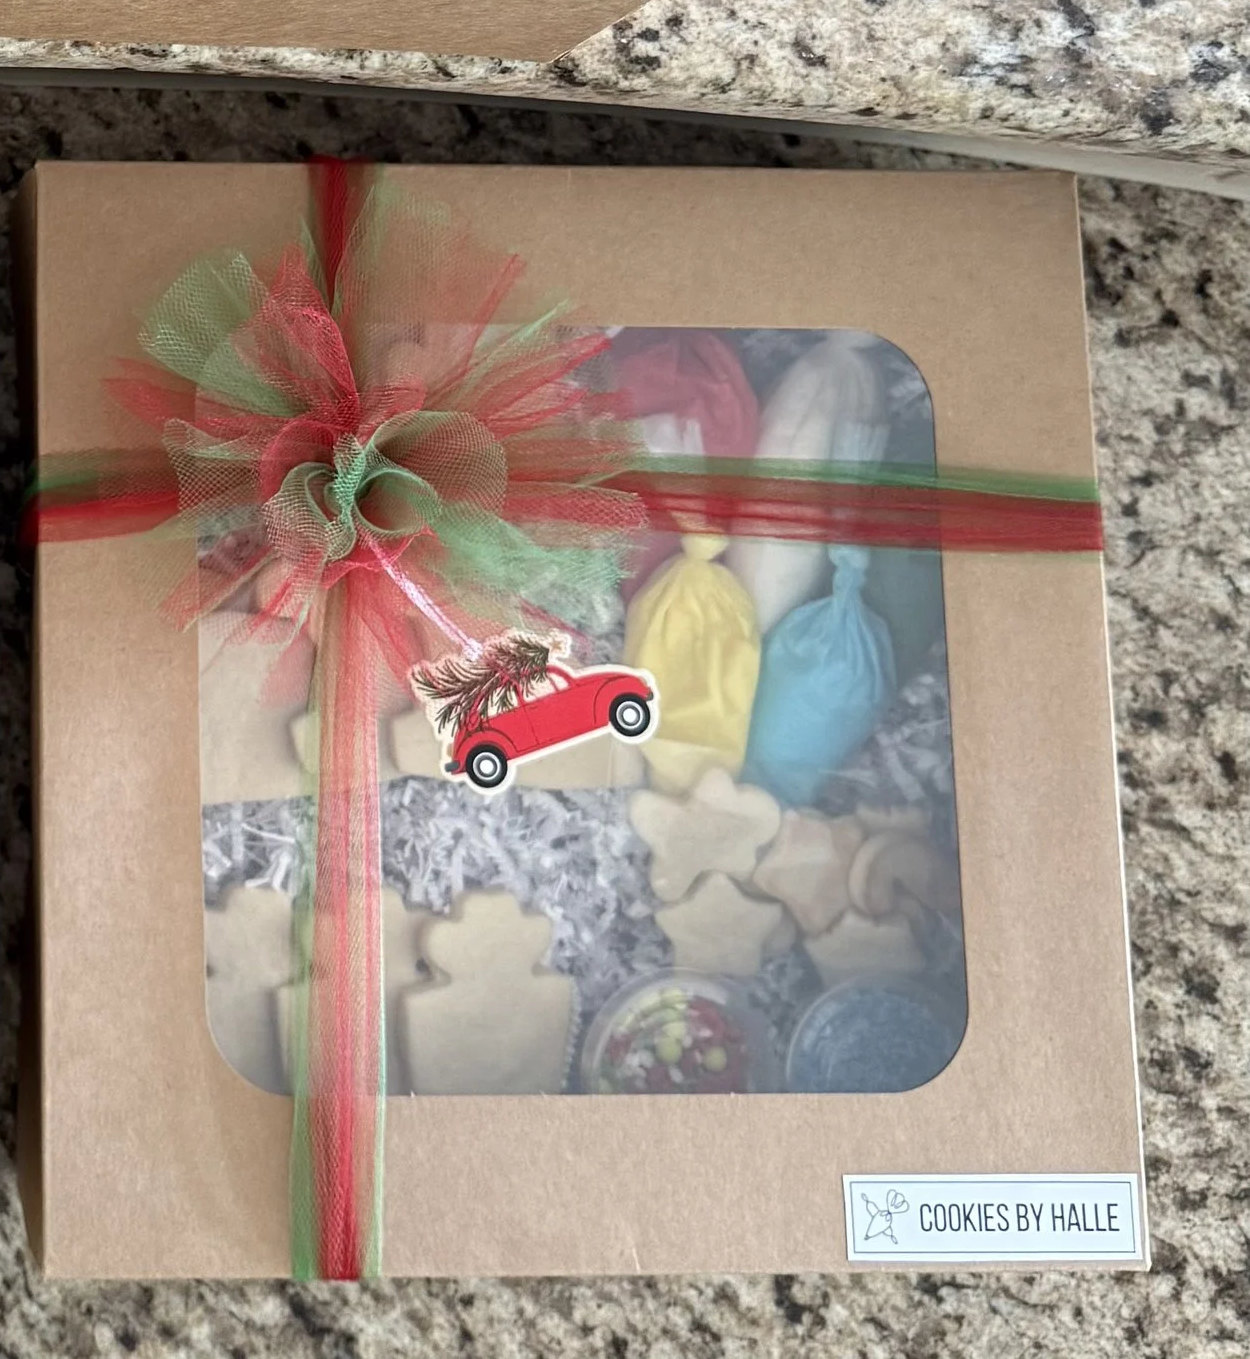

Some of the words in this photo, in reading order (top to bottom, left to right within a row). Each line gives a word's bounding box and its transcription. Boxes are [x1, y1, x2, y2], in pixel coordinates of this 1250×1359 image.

[919, 1203, 1010, 1232] COOKIES
[1017, 1202, 1044, 1232] BY
[1052, 1202, 1120, 1232] HALLE
